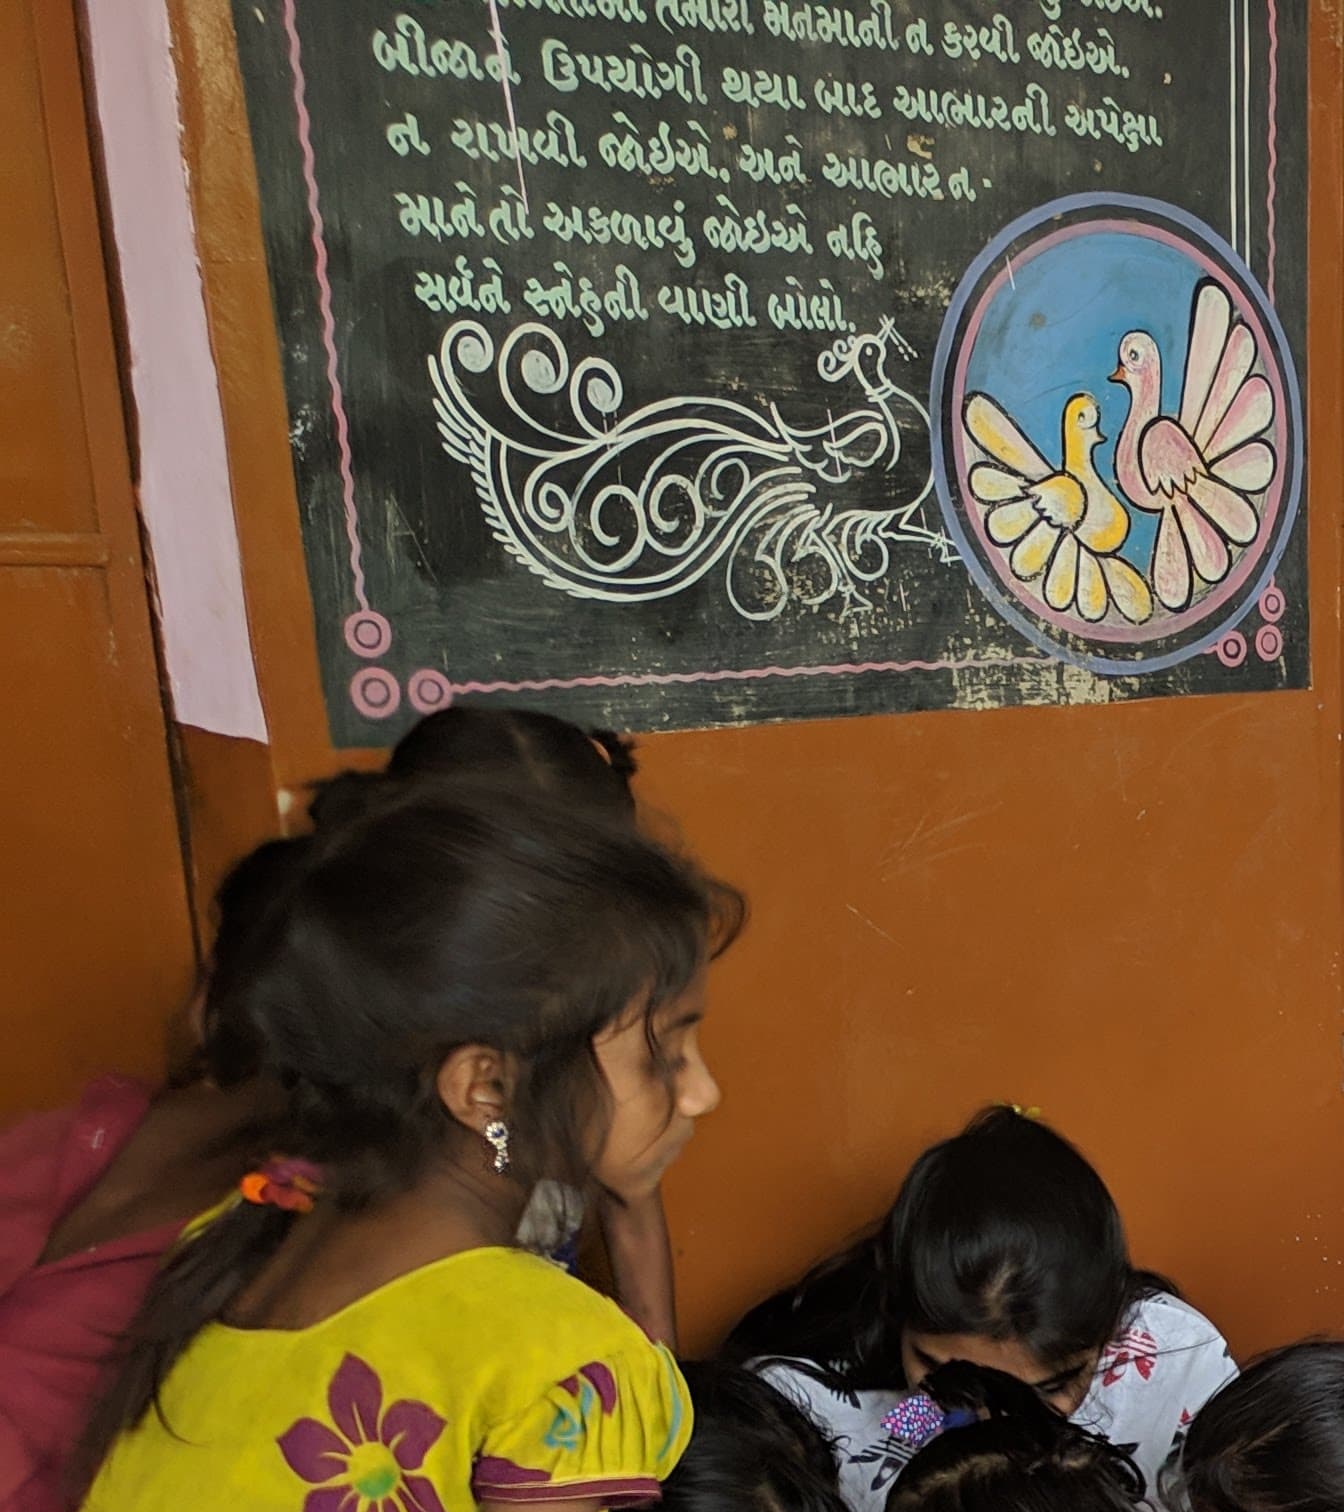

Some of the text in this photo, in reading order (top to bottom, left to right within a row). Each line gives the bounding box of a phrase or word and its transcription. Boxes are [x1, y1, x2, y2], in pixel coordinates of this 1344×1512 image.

[372, 14, 1164, 152] બીજાને ઉપયોગી થયા બાદ આભારની અપેક્ષા
[905, 17, 934, 56] ન
[941, 14, 1021, 64] કરવી
[386, 112, 431, 157] ન
[450, 110, 589, 169] રાખવી
[739, 134, 808, 185] અને
[821, 152, 942, 200] આભાર
[394, 180, 486, 240] માને
[488, 185, 536, 246] તો
[542, 200, 698, 270] અકળાવું
[826, 211, 884, 281] નહિ
[414, 254, 512, 315] સર્વને
[657, 272, 758, 330] વાણી
